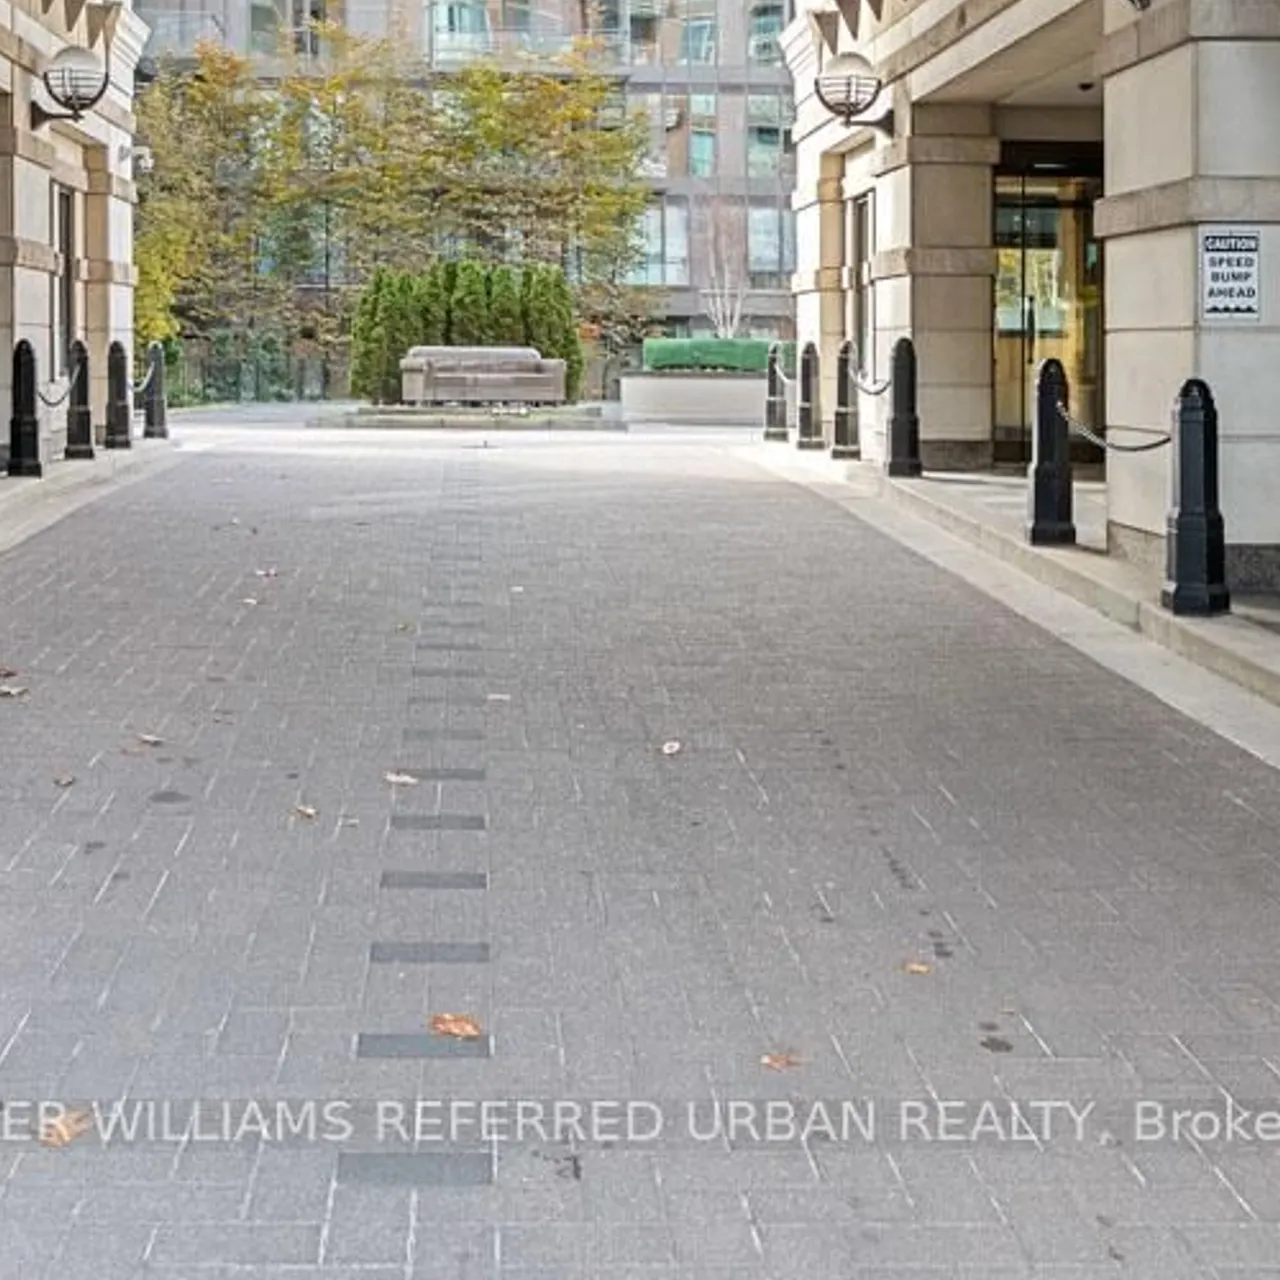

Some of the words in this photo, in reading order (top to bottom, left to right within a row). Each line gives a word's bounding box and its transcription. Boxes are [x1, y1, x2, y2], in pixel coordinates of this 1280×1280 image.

[1206, 237, 1256, 249] CAUTION
[1208, 256, 1255, 268] SPEED
[1210, 271, 1252, 283] BUMP
[1207, 286, 1256, 299] AHEAD
